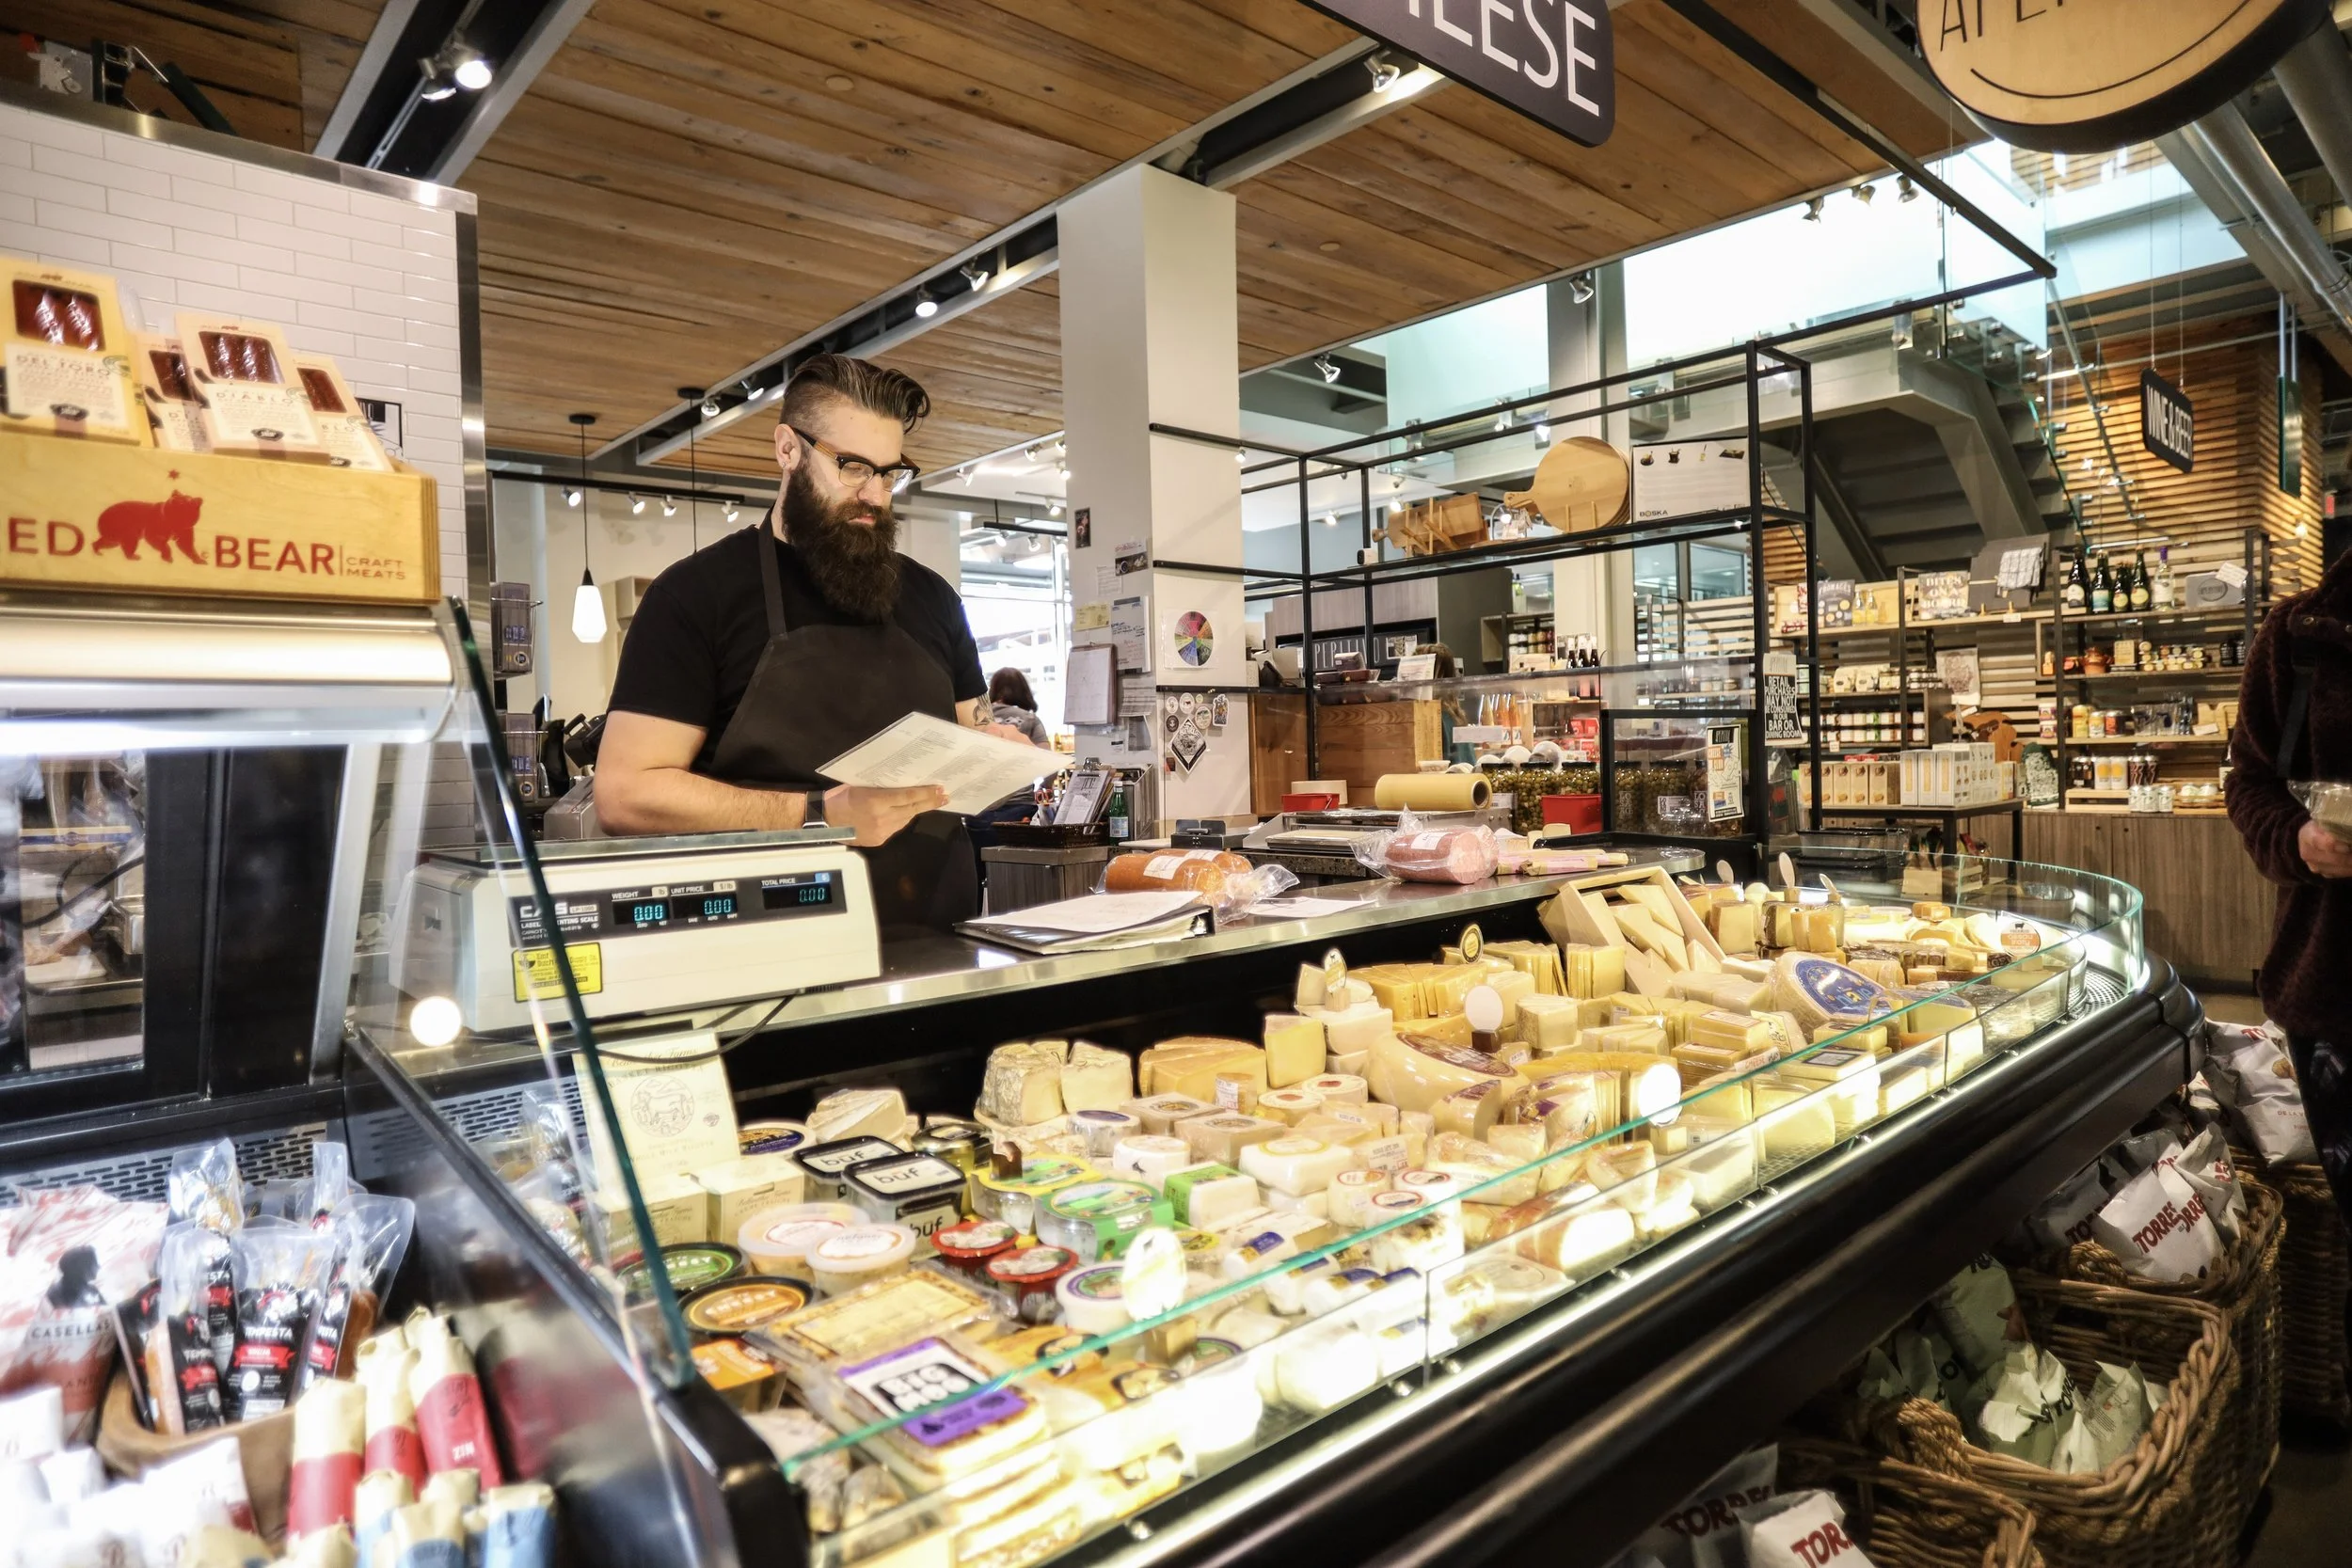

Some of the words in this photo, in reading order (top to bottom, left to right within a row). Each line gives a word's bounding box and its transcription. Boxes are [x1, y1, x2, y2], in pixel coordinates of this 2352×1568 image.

[216, 390, 289, 404] DIABLO
[321, 422, 357, 433] BLO
[1639, 509, 1669, 517] BOSKA
[8, 515, 85, 558] ED
[215, 534, 335, 577] BEAR
[345, 556, 404, 568] CRAFT
[346, 567, 406, 580] MEATS
[1926, 576, 1963, 586] BITES
[1929, 587, 1947, 597] ON
[1949, 587, 1960, 596] A
[1768, 675, 1789, 688] RETAIL
[1765, 686, 1796, 696] PURCHASES
[1766, 695, 1780, 706] MAY
[1781, 695, 1794, 706] NOT
[1771, 705, 1796, 714] CONSUMED
[1769, 720, 1783, 731] BAR
[1784, 720, 1795, 731] OR
[1765, 730, 1783, 739] DINING
[1783, 730, 1803, 739] ROOM
[612, 890, 639, 900] WEIGHT
[688, 885, 705, 894] PRICE
[519, 902, 567, 919] CS
[704, 898, 732, 915] 0.00
[633, 905, 663, 922] 0.00
[520, 921, 541, 929] LABEL
[2132, 1200, 2177, 1254] TORRES
[31, 1319, 110, 1338] CASELLAS
[244, 1325, 293, 1340] TEMPESTA
[878, 1363, 949, 1397] BIG
[452, 1440, 475, 1461] ZIN
[1789, 1520, 1856, 1568] TOR
